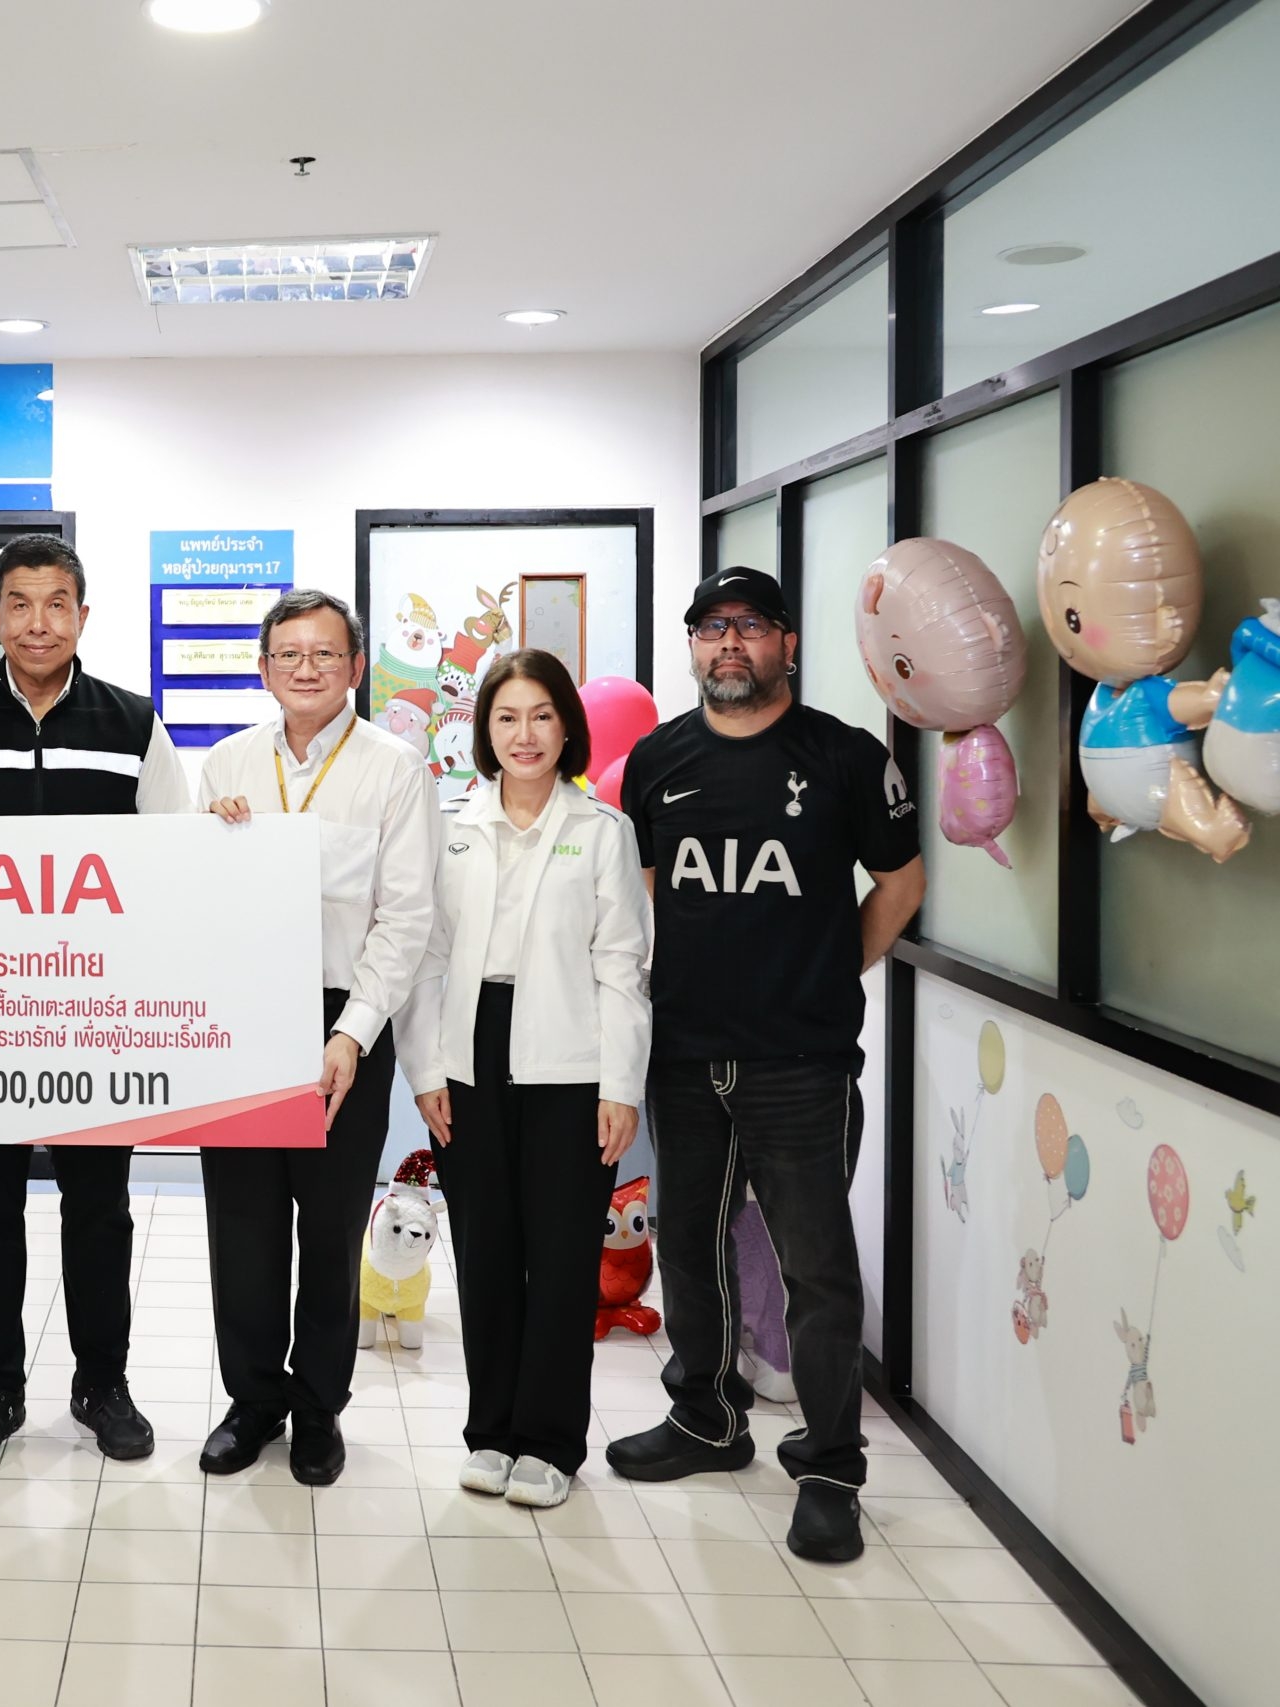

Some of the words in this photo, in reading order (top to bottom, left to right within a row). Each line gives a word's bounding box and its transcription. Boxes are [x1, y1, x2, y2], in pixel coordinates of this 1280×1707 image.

[180, 535, 264, 552] แพทย์ประจำ
[162, 557, 263, 580] หอผู้ป่วยกุมารฯ
[265, 561, 281, 575] 17
[672, 837, 802, 896] AIA
[134, 999, 206, 1025] สมทบทุน
[74, 1020, 232, 1055] เพื่อผู้ป่วยมะเร็งเด็ก
[110, 1071, 169, 1105] บาท
